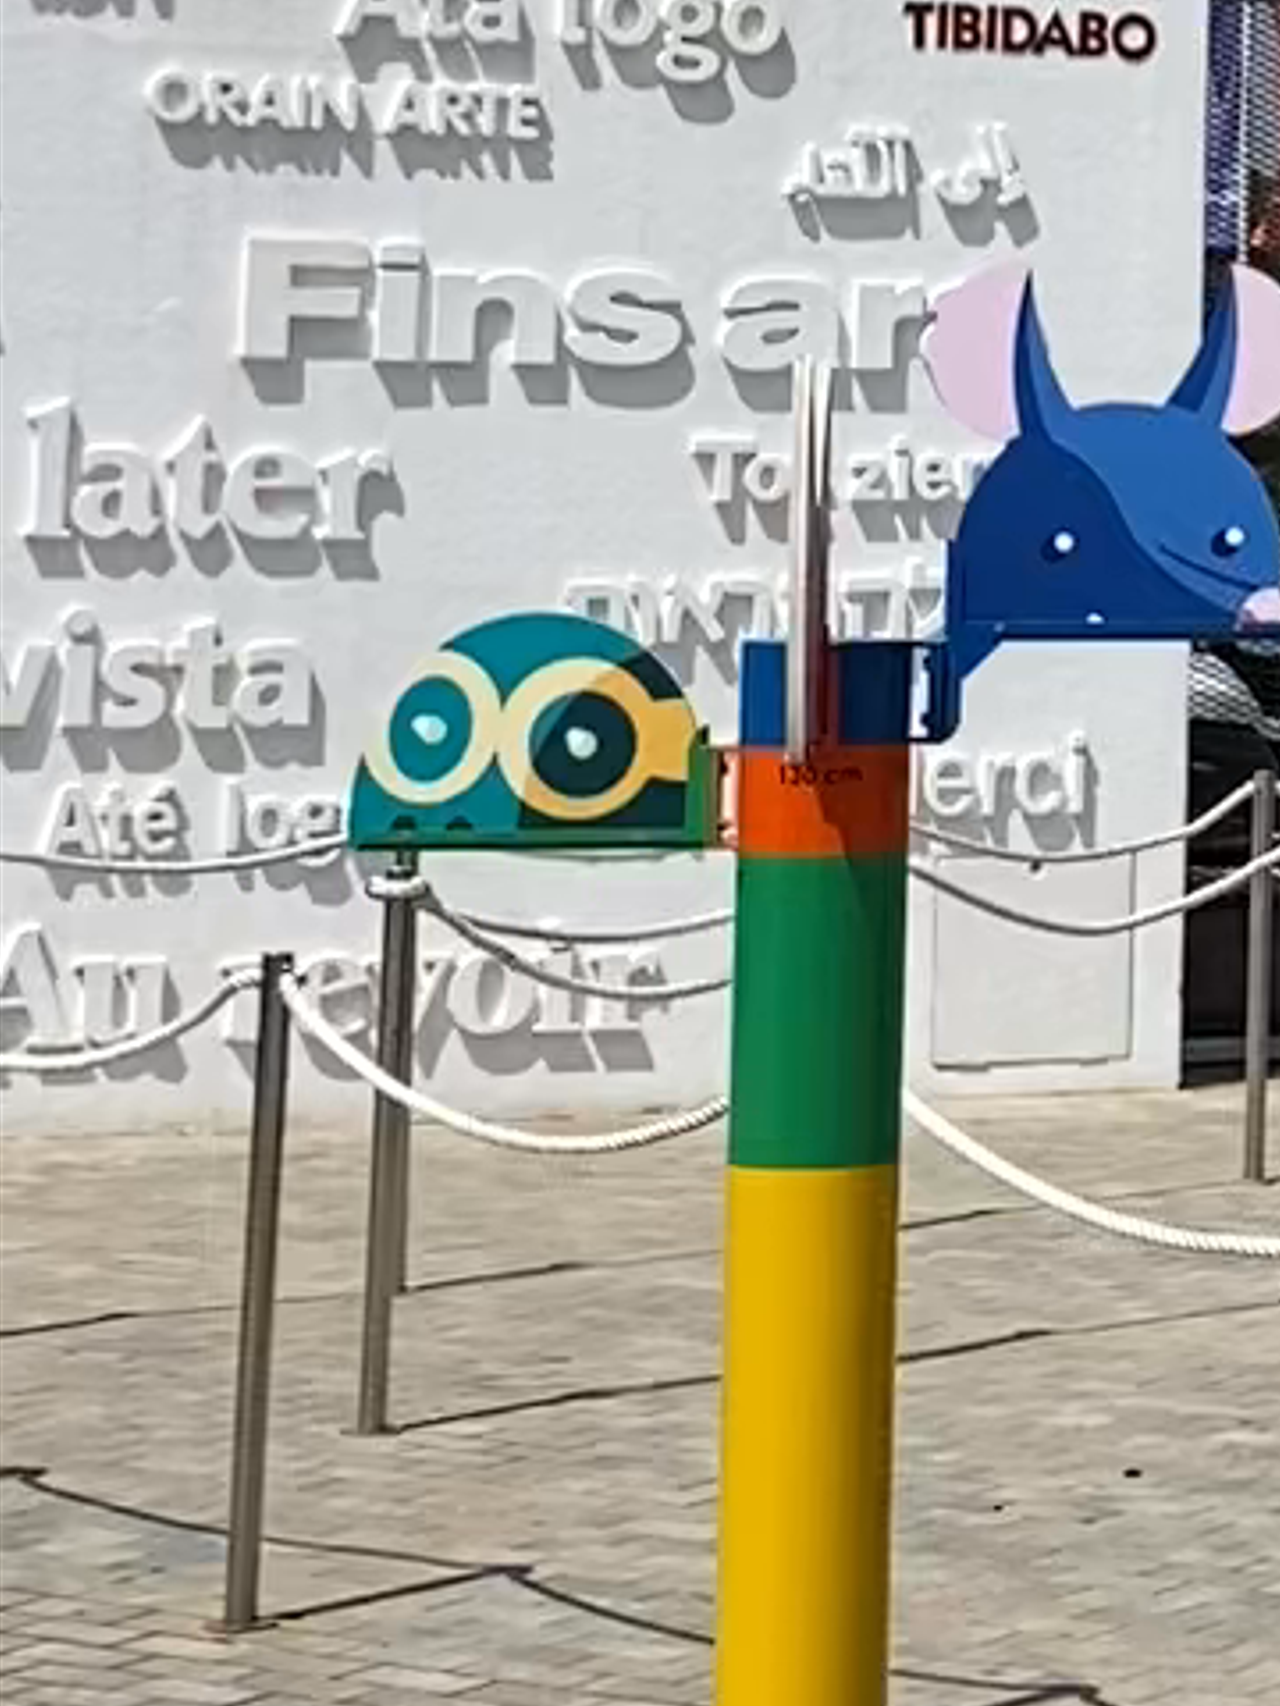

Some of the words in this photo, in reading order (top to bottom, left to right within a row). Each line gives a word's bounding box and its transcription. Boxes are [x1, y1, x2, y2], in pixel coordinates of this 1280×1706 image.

[904, 1, 1156, 62] TIBIDABO
[148, 67, 358, 132] ORAIN
[378, 83, 546, 138] ARTE
[19, 397, 395, 539] later
[36, 782, 180, 858] Até
[222, 776, 345, 866] log
